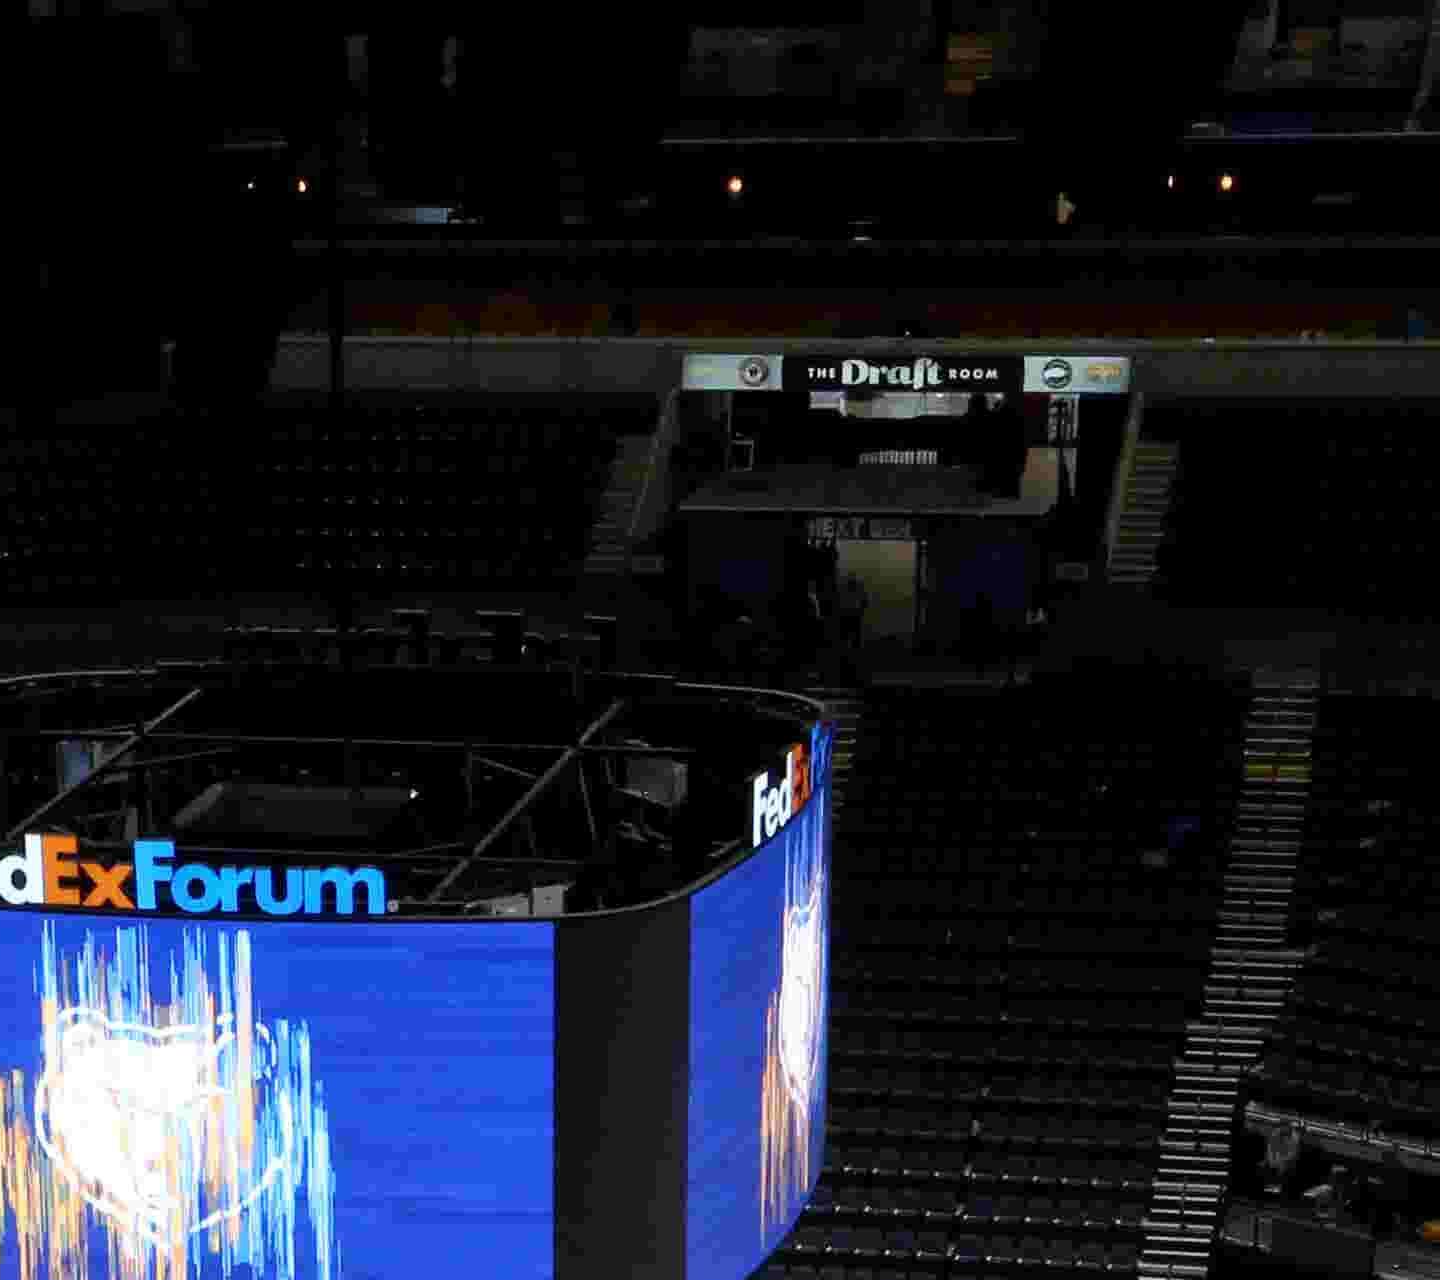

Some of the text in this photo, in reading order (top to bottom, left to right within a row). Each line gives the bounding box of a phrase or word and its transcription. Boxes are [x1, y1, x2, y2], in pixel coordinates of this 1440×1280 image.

[807, 356, 998, 391] THE Draft ROOM
